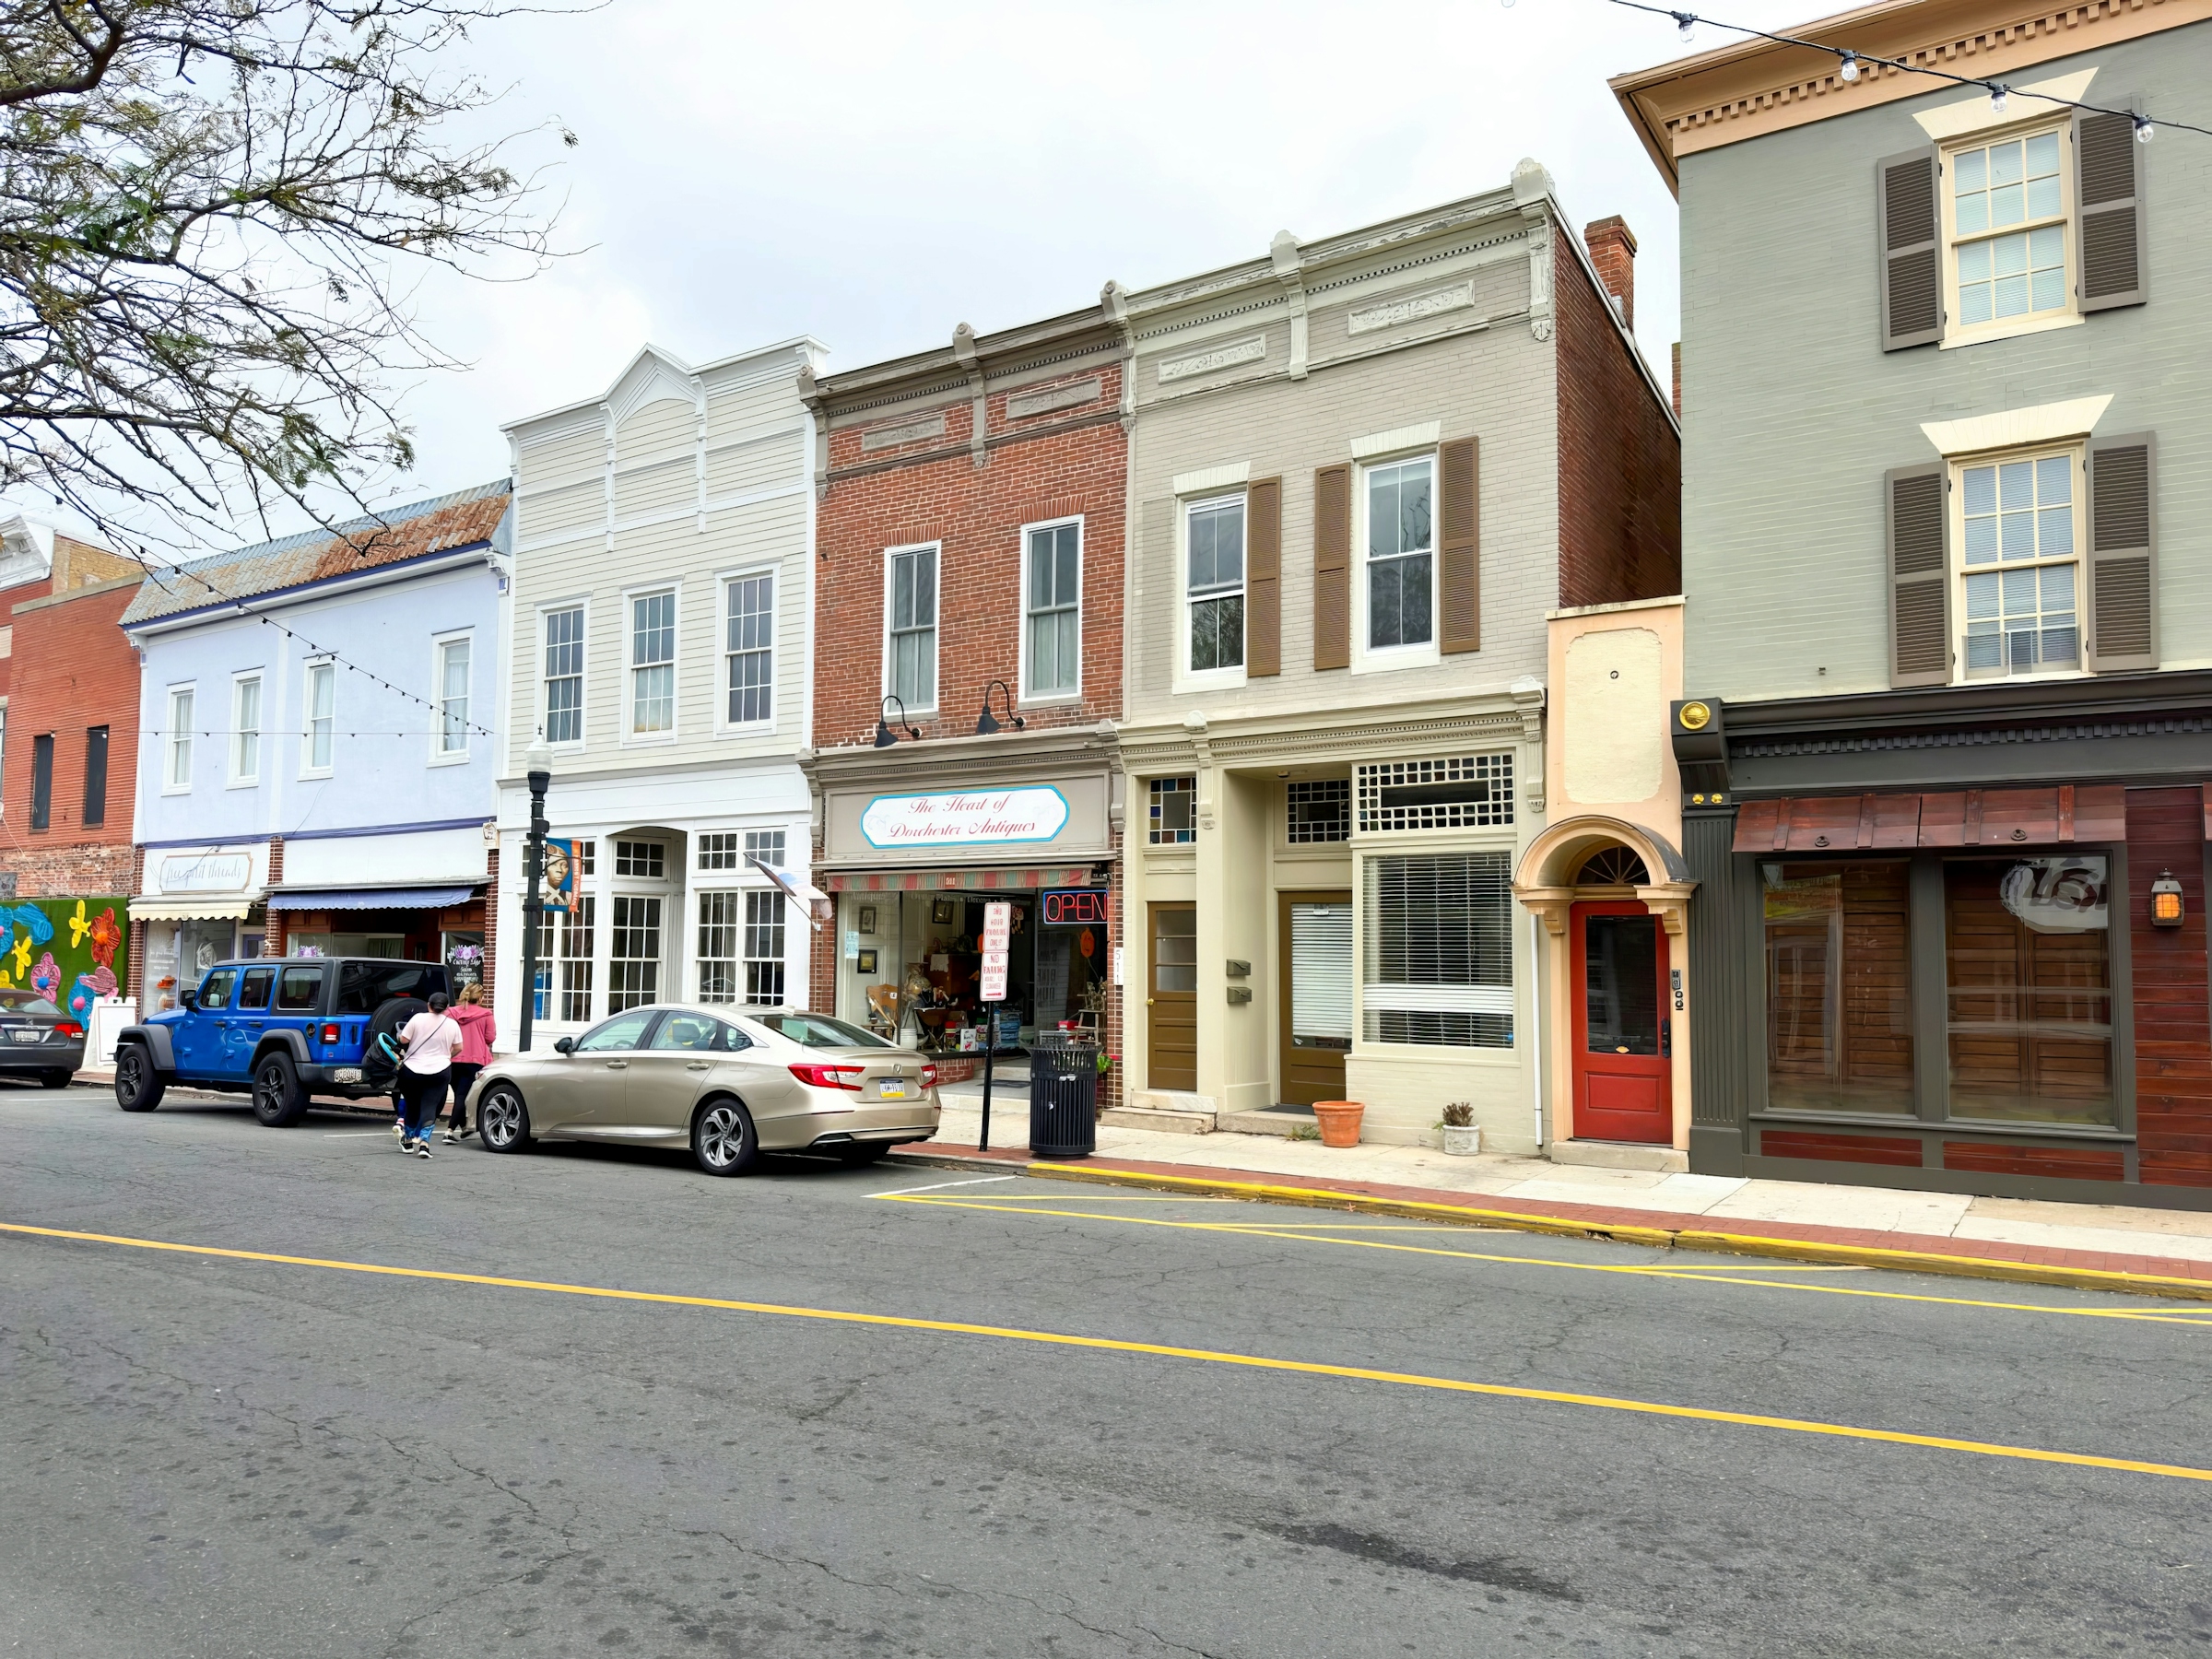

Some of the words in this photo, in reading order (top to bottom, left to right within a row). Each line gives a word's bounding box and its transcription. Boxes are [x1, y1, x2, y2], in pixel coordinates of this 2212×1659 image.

[908, 798, 936, 814] The
[942, 794, 989, 813] Heart
[992, 794, 1012, 814] of
[887, 821, 962, 838] Dorchester
[968, 818, 1037, 838] Antiques
[1046, 893, 1107, 922] OPEN
[990, 955, 1000, 963] NO
